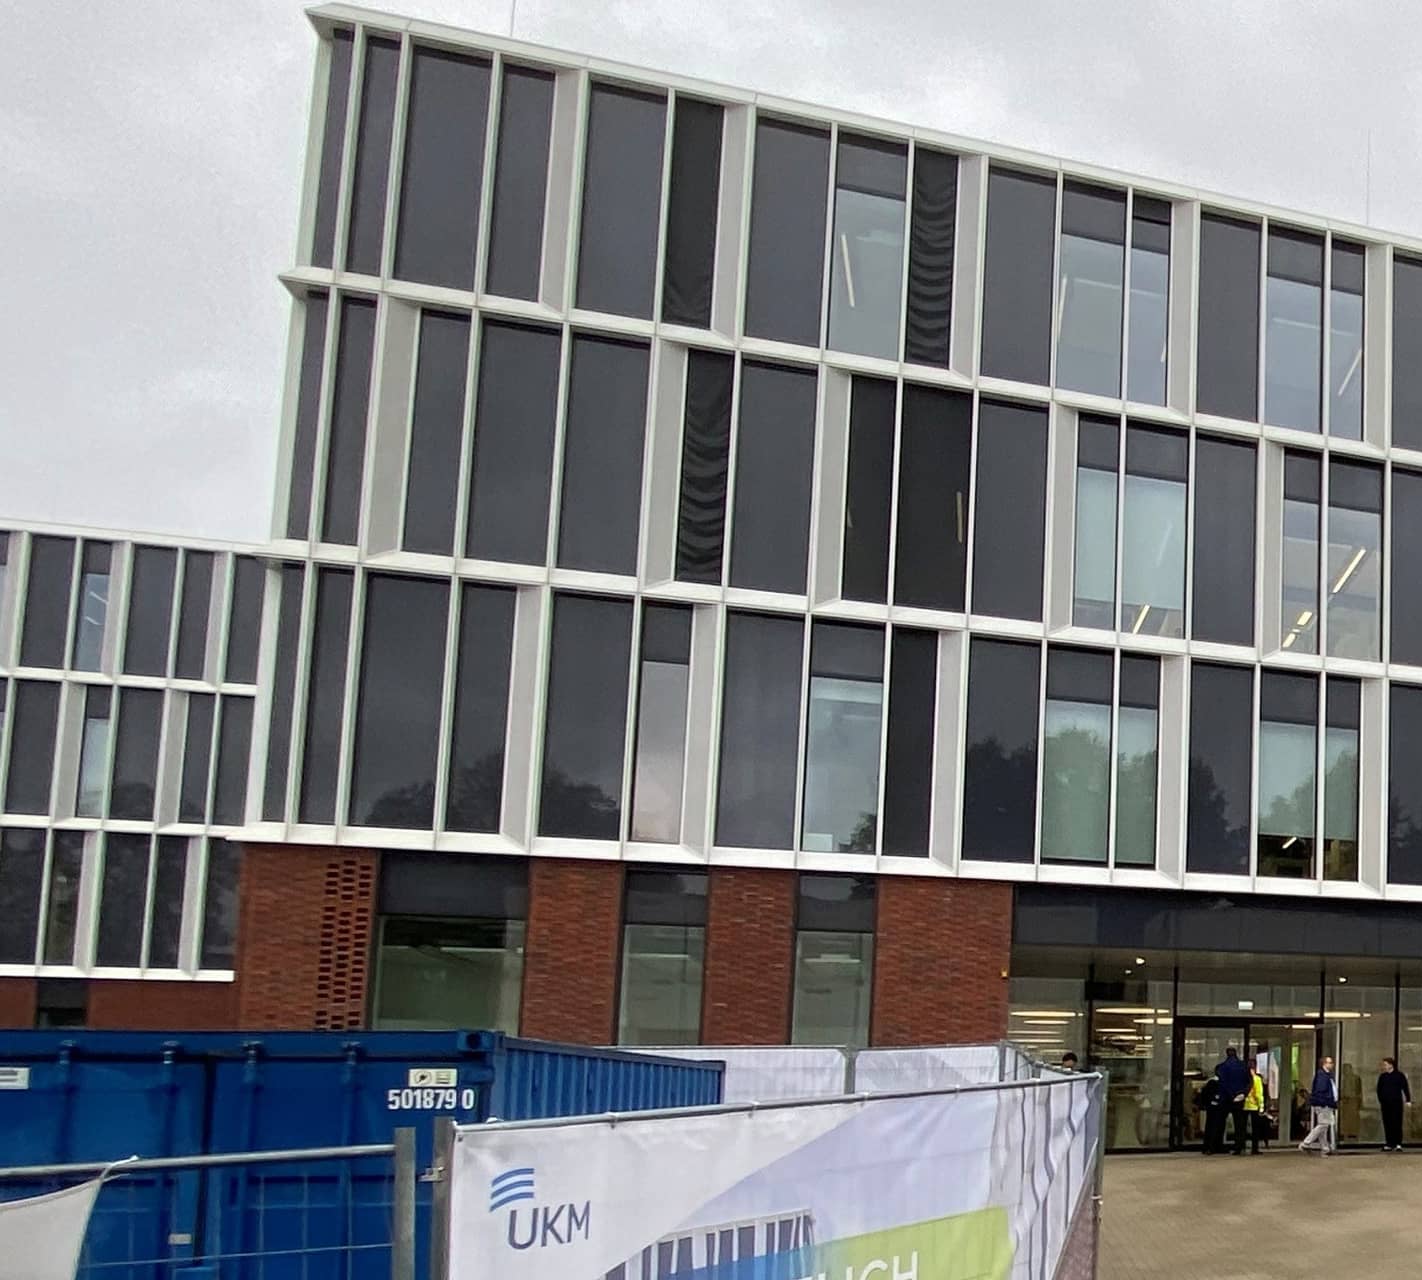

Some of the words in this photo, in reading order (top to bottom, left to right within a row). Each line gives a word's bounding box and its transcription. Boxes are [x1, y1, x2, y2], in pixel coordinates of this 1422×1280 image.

[387, 1088, 457, 1110] 501879
[461, 1088, 475, 1110] 0
[508, 1200, 591, 1250] UKM
